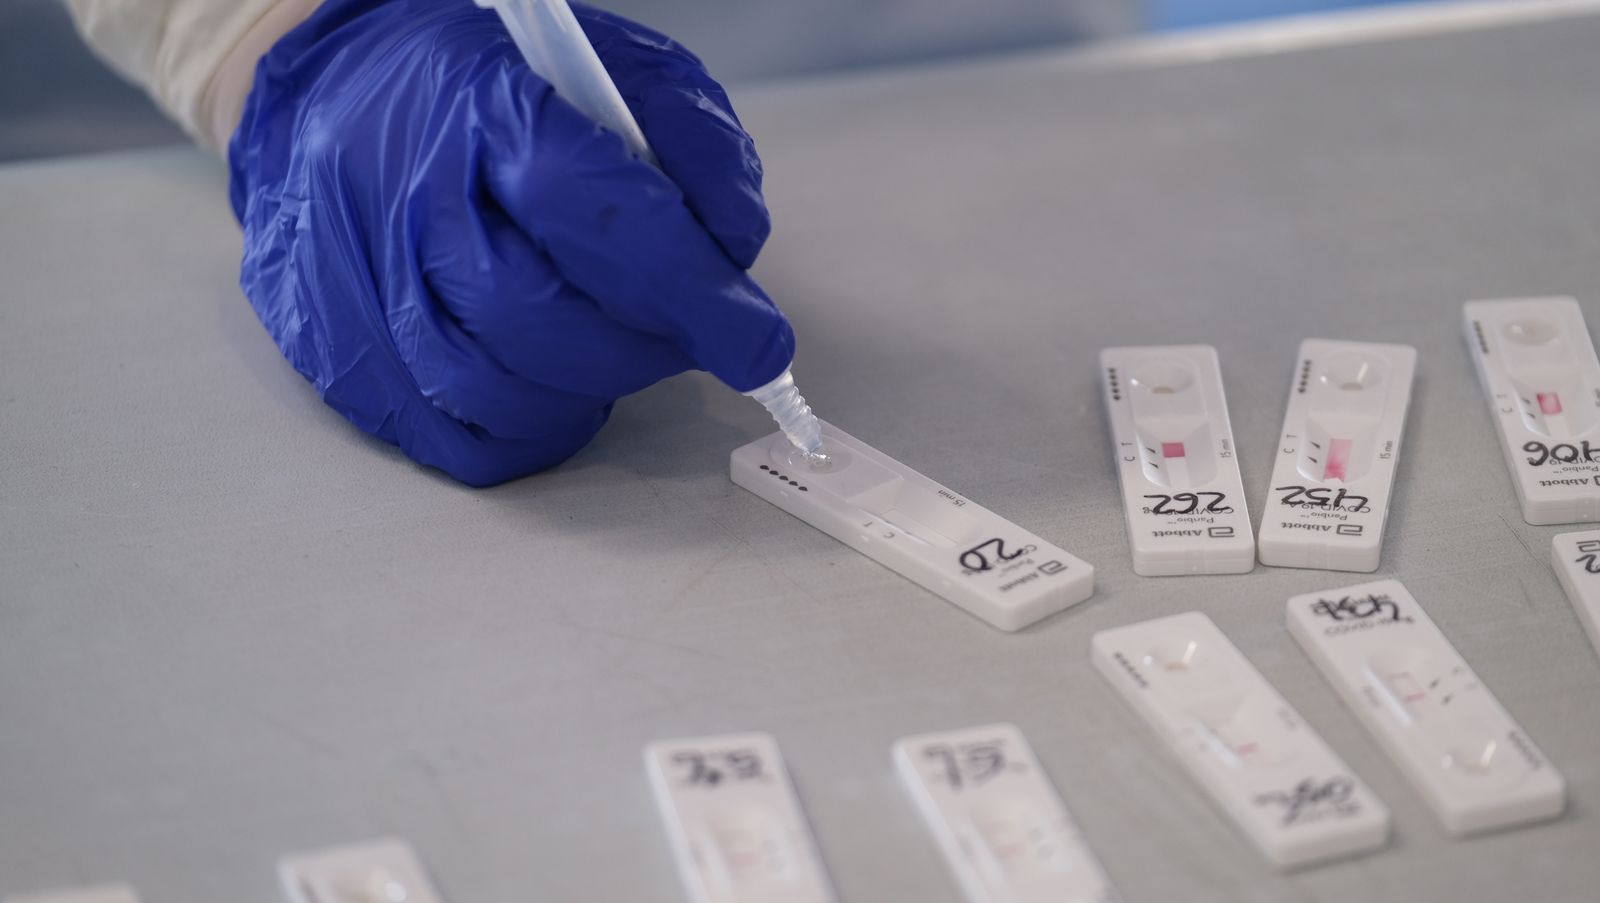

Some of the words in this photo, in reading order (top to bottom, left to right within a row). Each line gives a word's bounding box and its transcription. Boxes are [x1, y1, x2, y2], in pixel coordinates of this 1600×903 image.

[1539, 478, 1589, 487] Abbott
[1143, 492, 1231, 515] 262
[1275, 485, 1368, 512] 452
[1280, 522, 1332, 532] Abbott
[1152, 530, 1202, 538] Abbott
